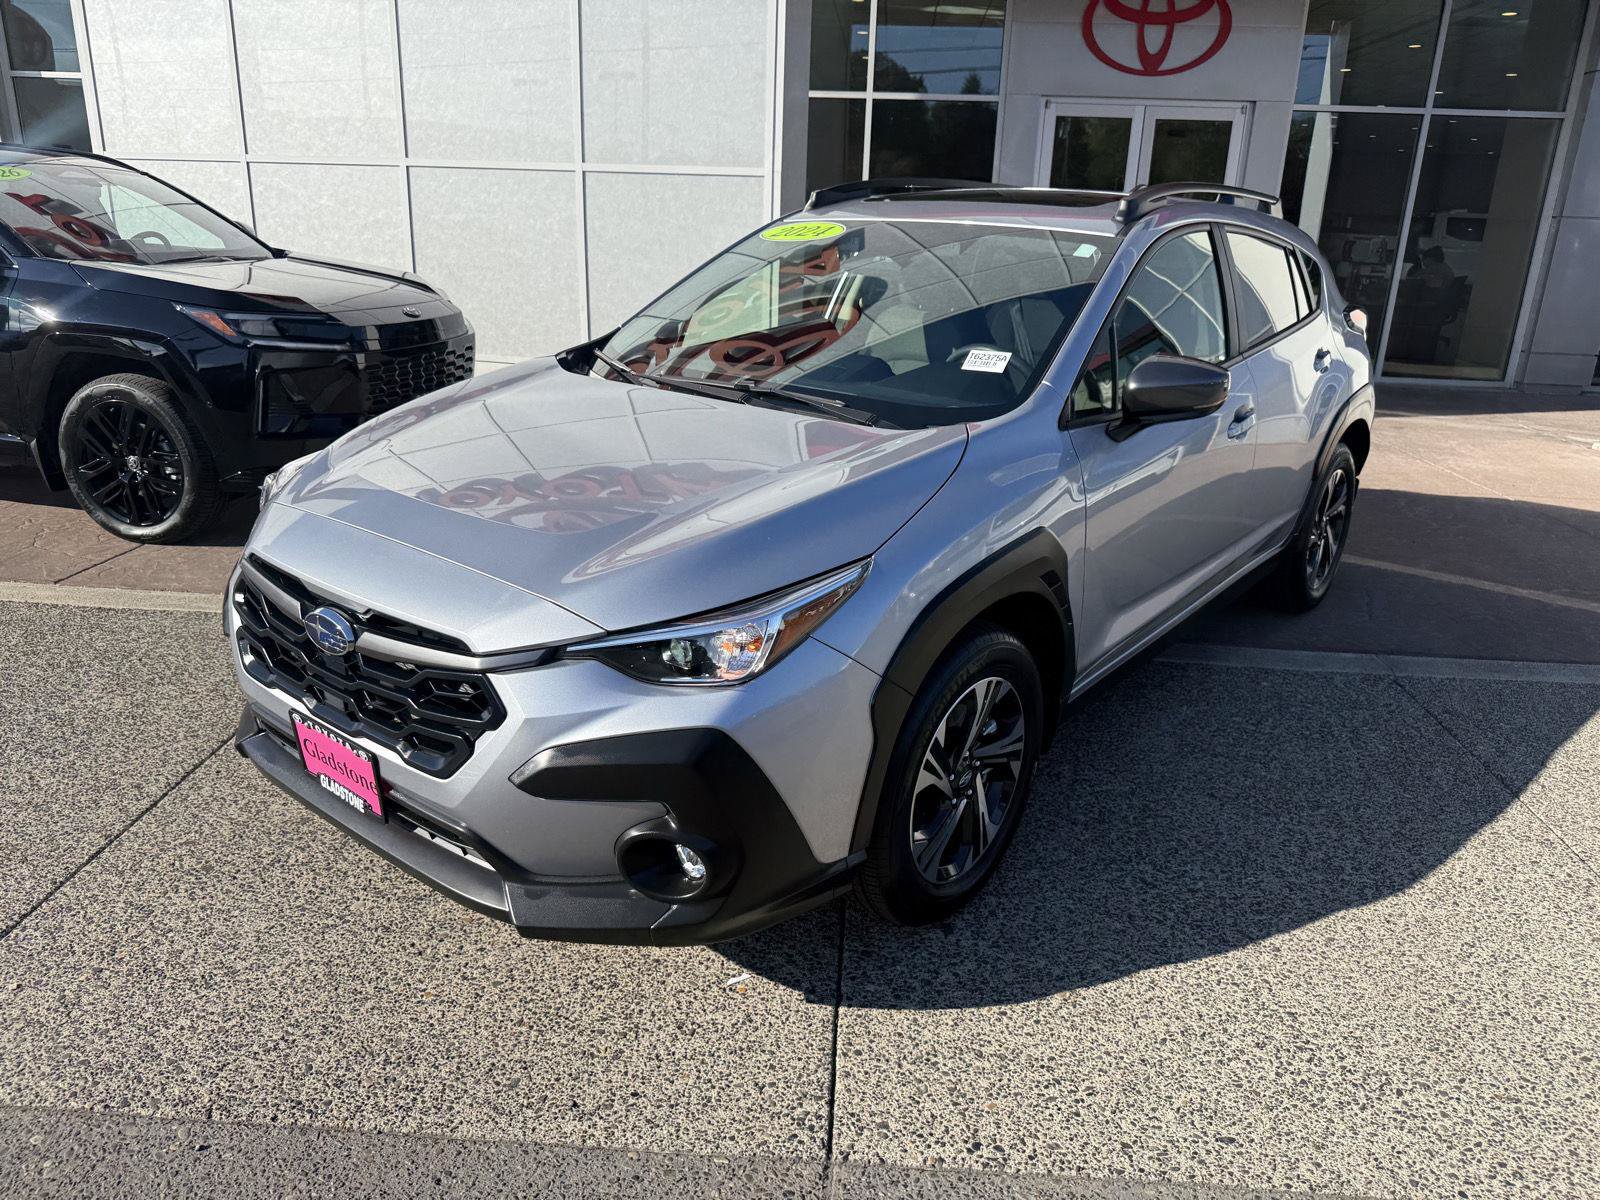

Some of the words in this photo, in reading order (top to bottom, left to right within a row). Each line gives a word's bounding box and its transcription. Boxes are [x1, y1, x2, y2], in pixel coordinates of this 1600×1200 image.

[769, 225, 837, 237] 2024
[307, 720, 352, 751] TOYOTA
[303, 738, 379, 797] Gladstone
[320, 774, 365, 813] GLADSTONE
